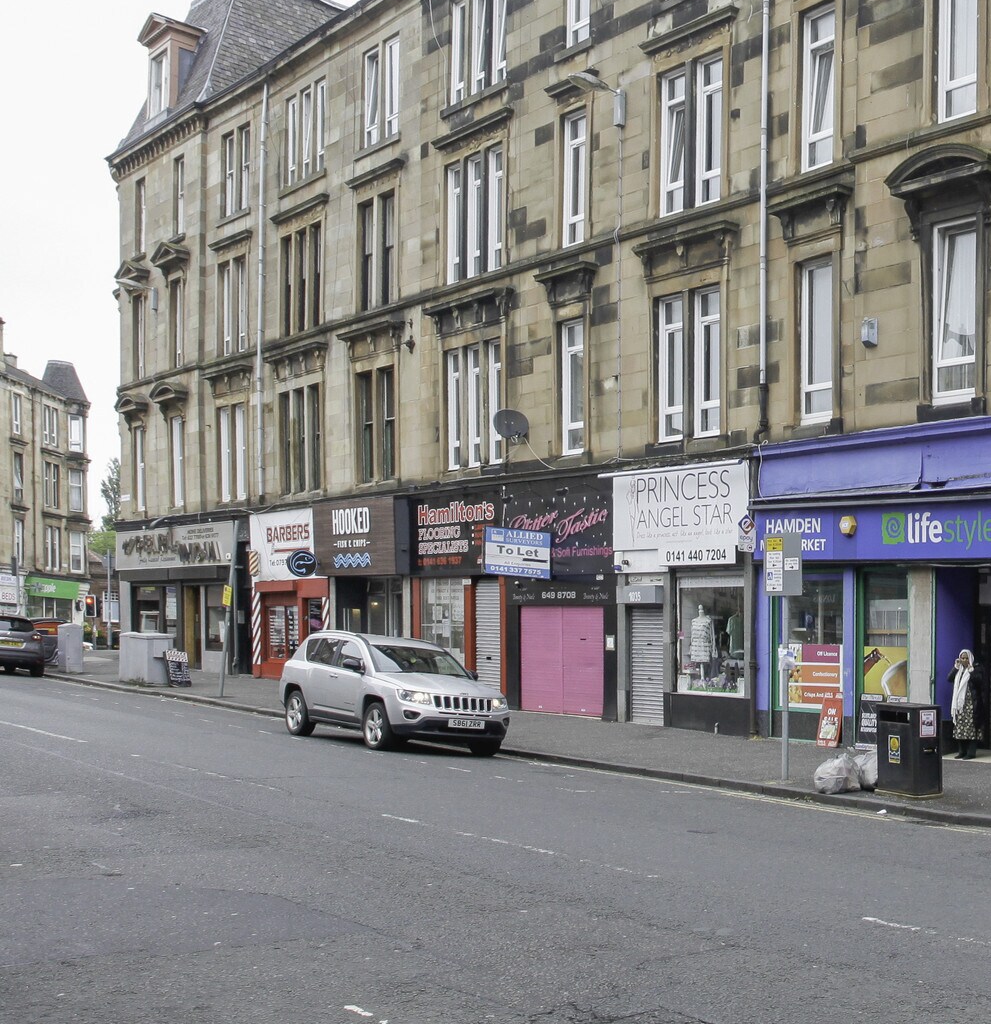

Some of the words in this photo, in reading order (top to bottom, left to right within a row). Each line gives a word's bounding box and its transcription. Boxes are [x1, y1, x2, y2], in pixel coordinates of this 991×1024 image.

[636, 469, 731, 505] PRINCESS
[417, 500, 495, 526] Hamilton's
[636, 506, 689, 530] ANGEL
[693, 503, 733, 527] STAR
[331, 506, 370, 536] HOOKED
[555, 507, 609, 544] Tastic
[765, 517, 821, 534] HAMDEN
[266, 523, 310, 543] BARBERS
[417, 525, 461, 541] FLOORING
[505, 530, 544, 542] ALLIED
[337, 540, 348, 548] FISH
[353, 539, 367, 547] CHIPS
[418, 540, 469, 555] SPECIALISTS
[505, 537, 544, 547] SURVEYORS
[496, 544, 514, 555] To
[516, 546, 539, 558] Let
[556, 546, 571, 557] Soft
[571, 544, 613, 558] Furnishings
[666, 550, 685, 562] 0141
[687, 550, 703, 562] 440
[705, 549, 727, 561] 7204
[490, 565, 508, 573] 0141
[523, 568, 542, 576] 7575
[1, 592, 16, 601] BEDS
[541, 591, 556, 599] 649
